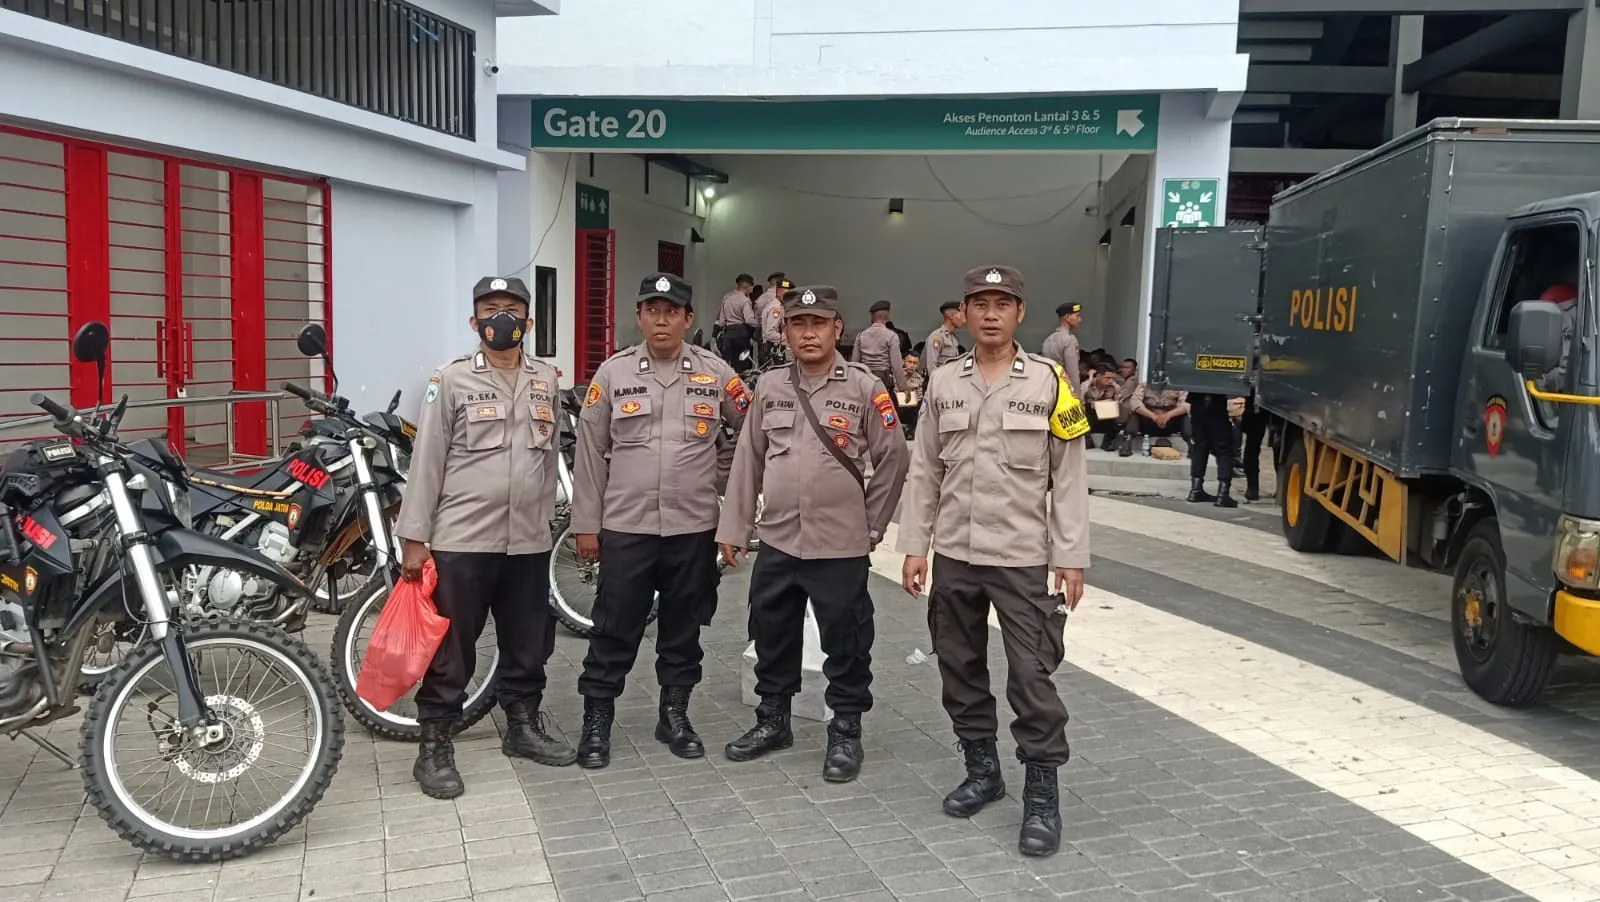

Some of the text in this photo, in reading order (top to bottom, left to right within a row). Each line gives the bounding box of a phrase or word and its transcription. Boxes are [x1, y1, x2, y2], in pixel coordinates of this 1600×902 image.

[543, 107, 667, 138] Gate 20
[943, 110, 1100, 123] Akses Penonton Lantai 3 & 5
[965, 125, 1007, 136] Audience
[1007, 126, 1038, 136] Access
[1053, 125, 1062, 135] &
[1075, 124, 1101, 135] Floor
[1290, 286, 1357, 332] POLISI
[467, 392, 498, 402] R.EKA
[686, 387, 719, 399] POLRI
[825, 400, 860, 413] POLRI
[1008, 401, 1045, 415] POLRI
[286, 459, 331, 489] POLISI
[253, 500, 273, 511] POLDA
